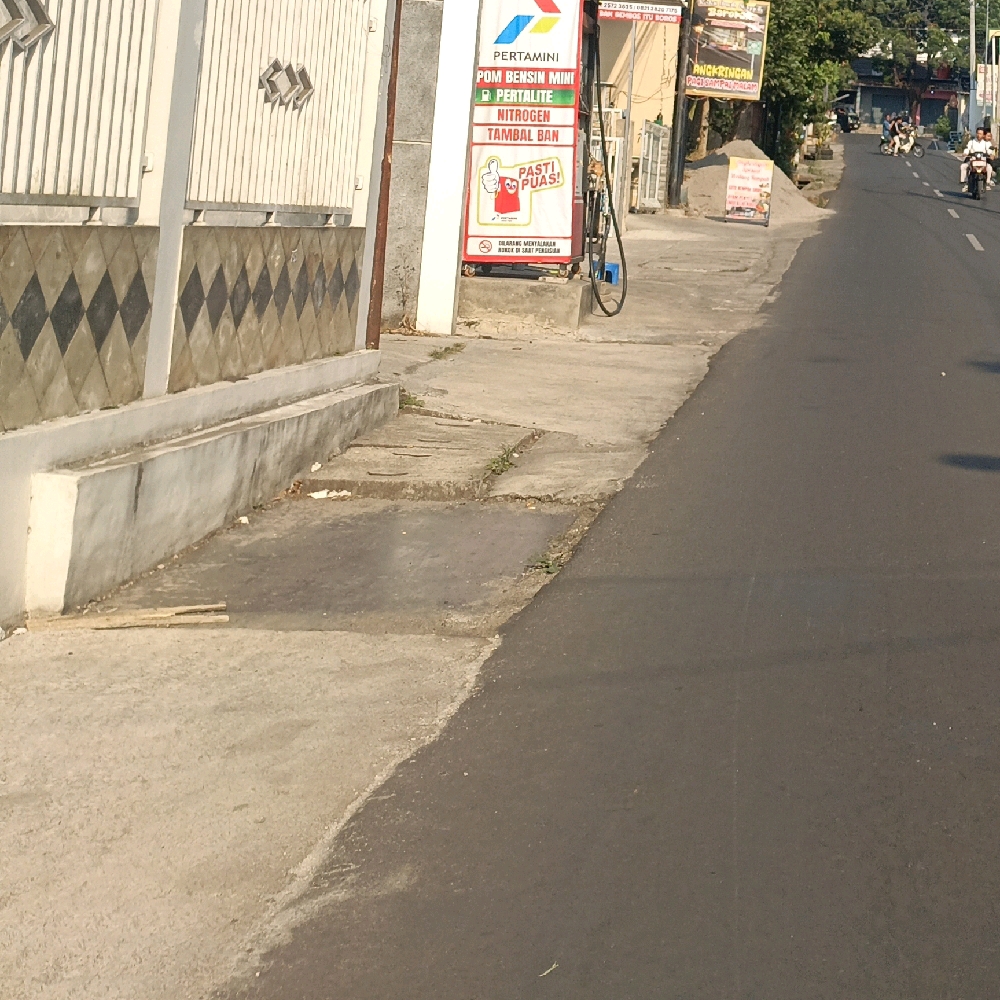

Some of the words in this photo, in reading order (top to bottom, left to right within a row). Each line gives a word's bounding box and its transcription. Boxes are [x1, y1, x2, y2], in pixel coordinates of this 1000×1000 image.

[493, 51, 559, 62] PERTAMINI
[477, 70, 502, 84] POM
[505, 70, 546, 84] BENSIN
[548, 71, 575, 85] MINI
[693, 64, 754, 80] ANGKRINGAN
[687, 75, 704, 87] PAGI
[732, 80, 758, 92] MALAM
[496, 89, 553, 103] PERTALITE
[497, 109, 550, 122] NITROGEN
[487, 128, 533, 142] TAMBAL
[537, 130, 559, 142] BAN
[518, 161, 555, 179] PASTI
[521, 172, 560, 190] PUAS!
